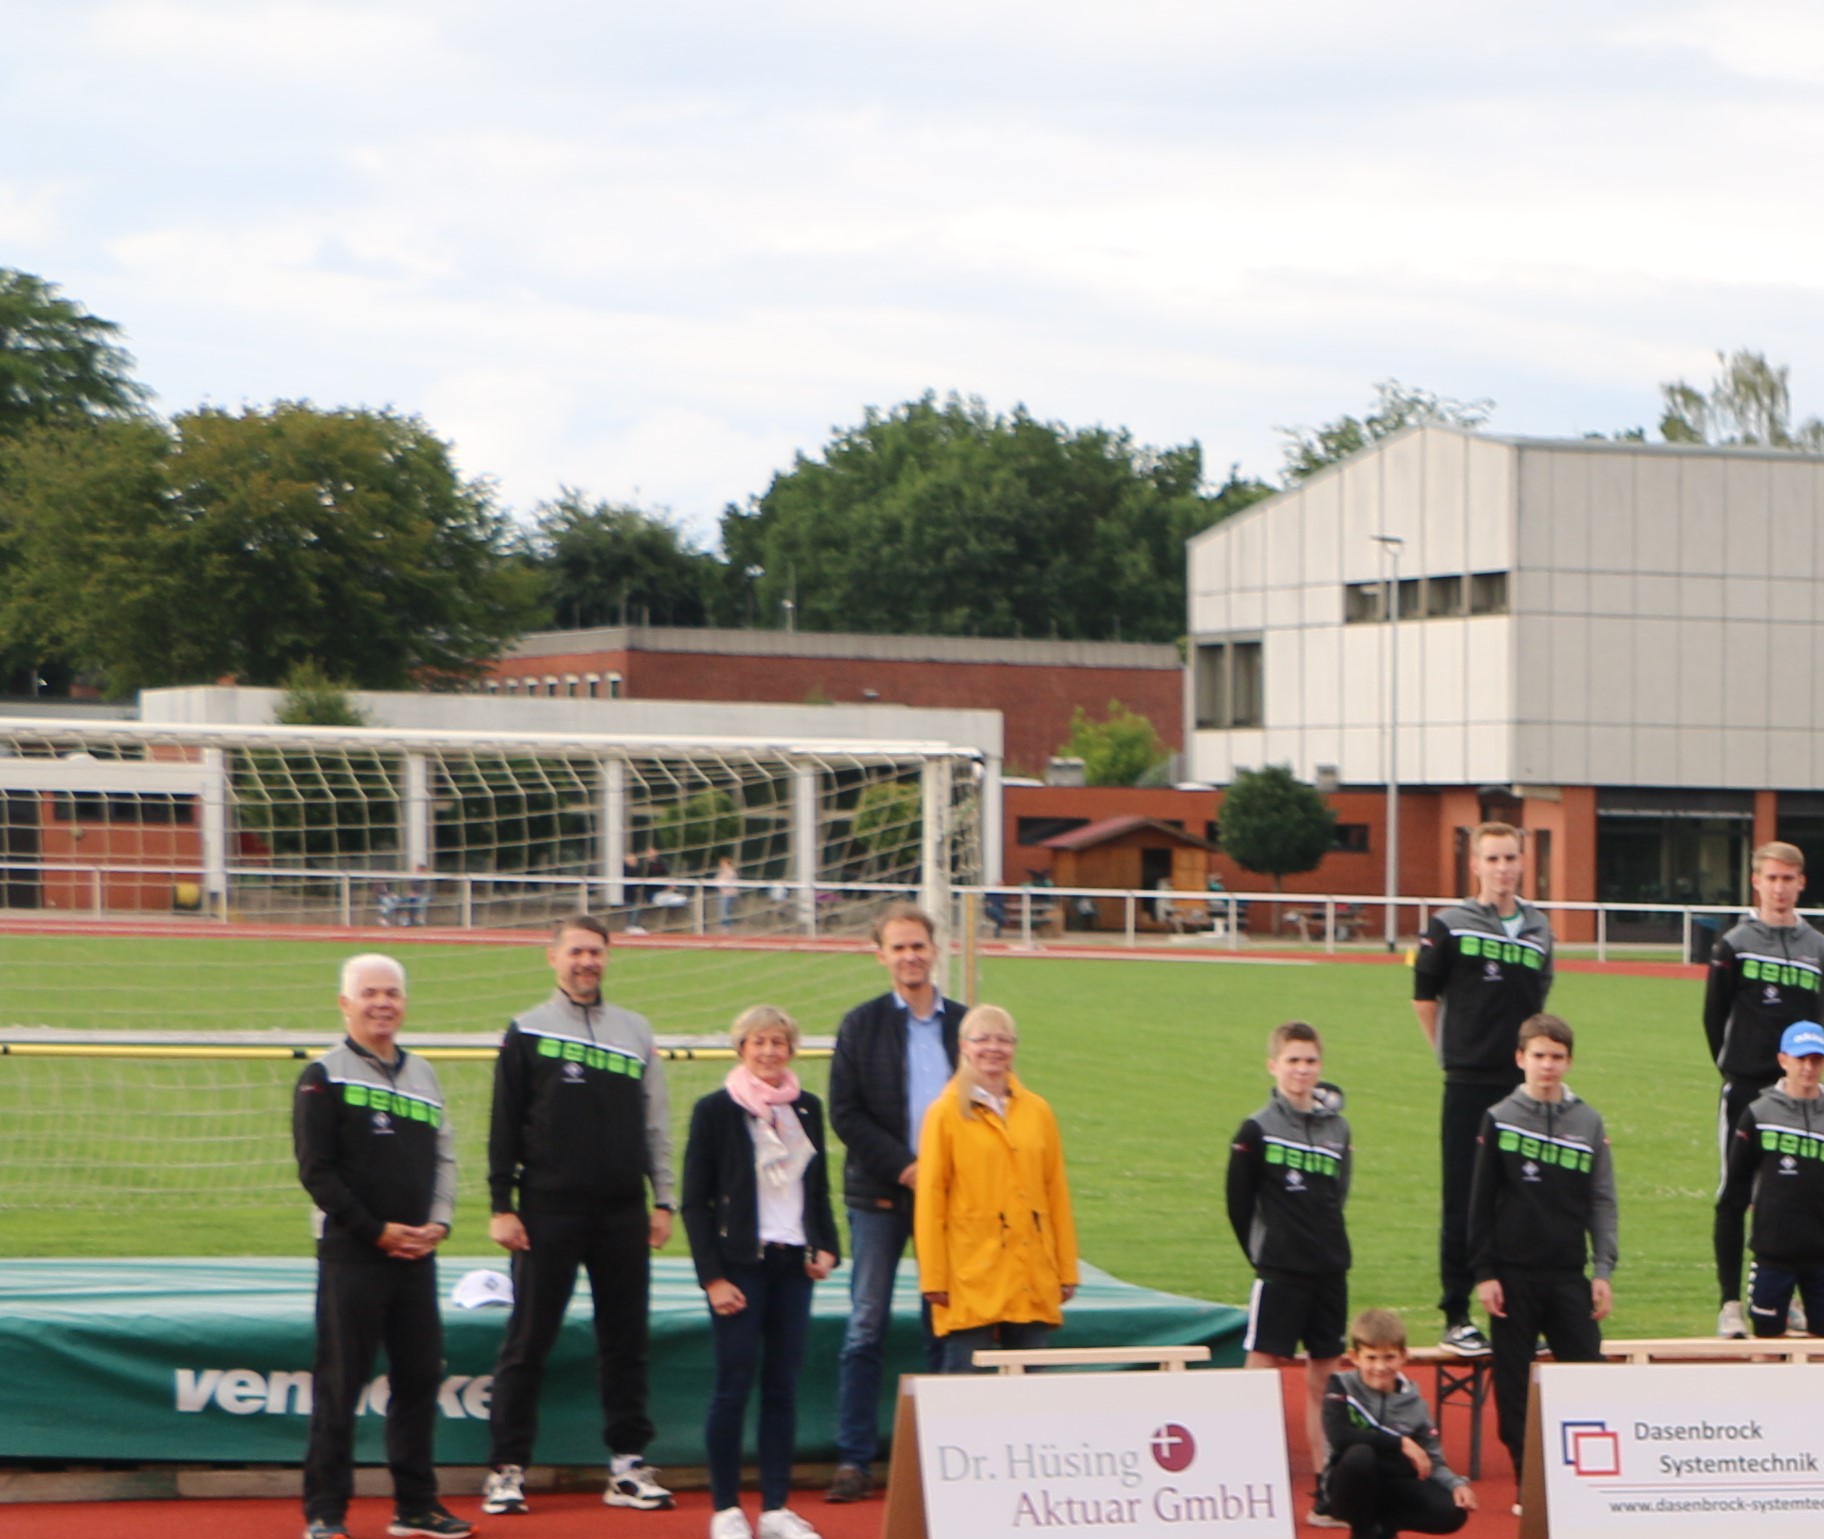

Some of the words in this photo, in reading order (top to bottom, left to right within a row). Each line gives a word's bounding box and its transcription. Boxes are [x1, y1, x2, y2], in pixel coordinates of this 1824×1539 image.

[1634, 1420, 1763, 1440] Dasenbrock
[937, 1445, 997, 1481] Dr.
[1005, 1443, 1142, 1487] Hüsing
[1659, 1453, 1818, 1478] Systemtechnik
[1012, 1490, 1142, 1527] Aktuar
[1153, 1484, 1277, 1523] GmbH
